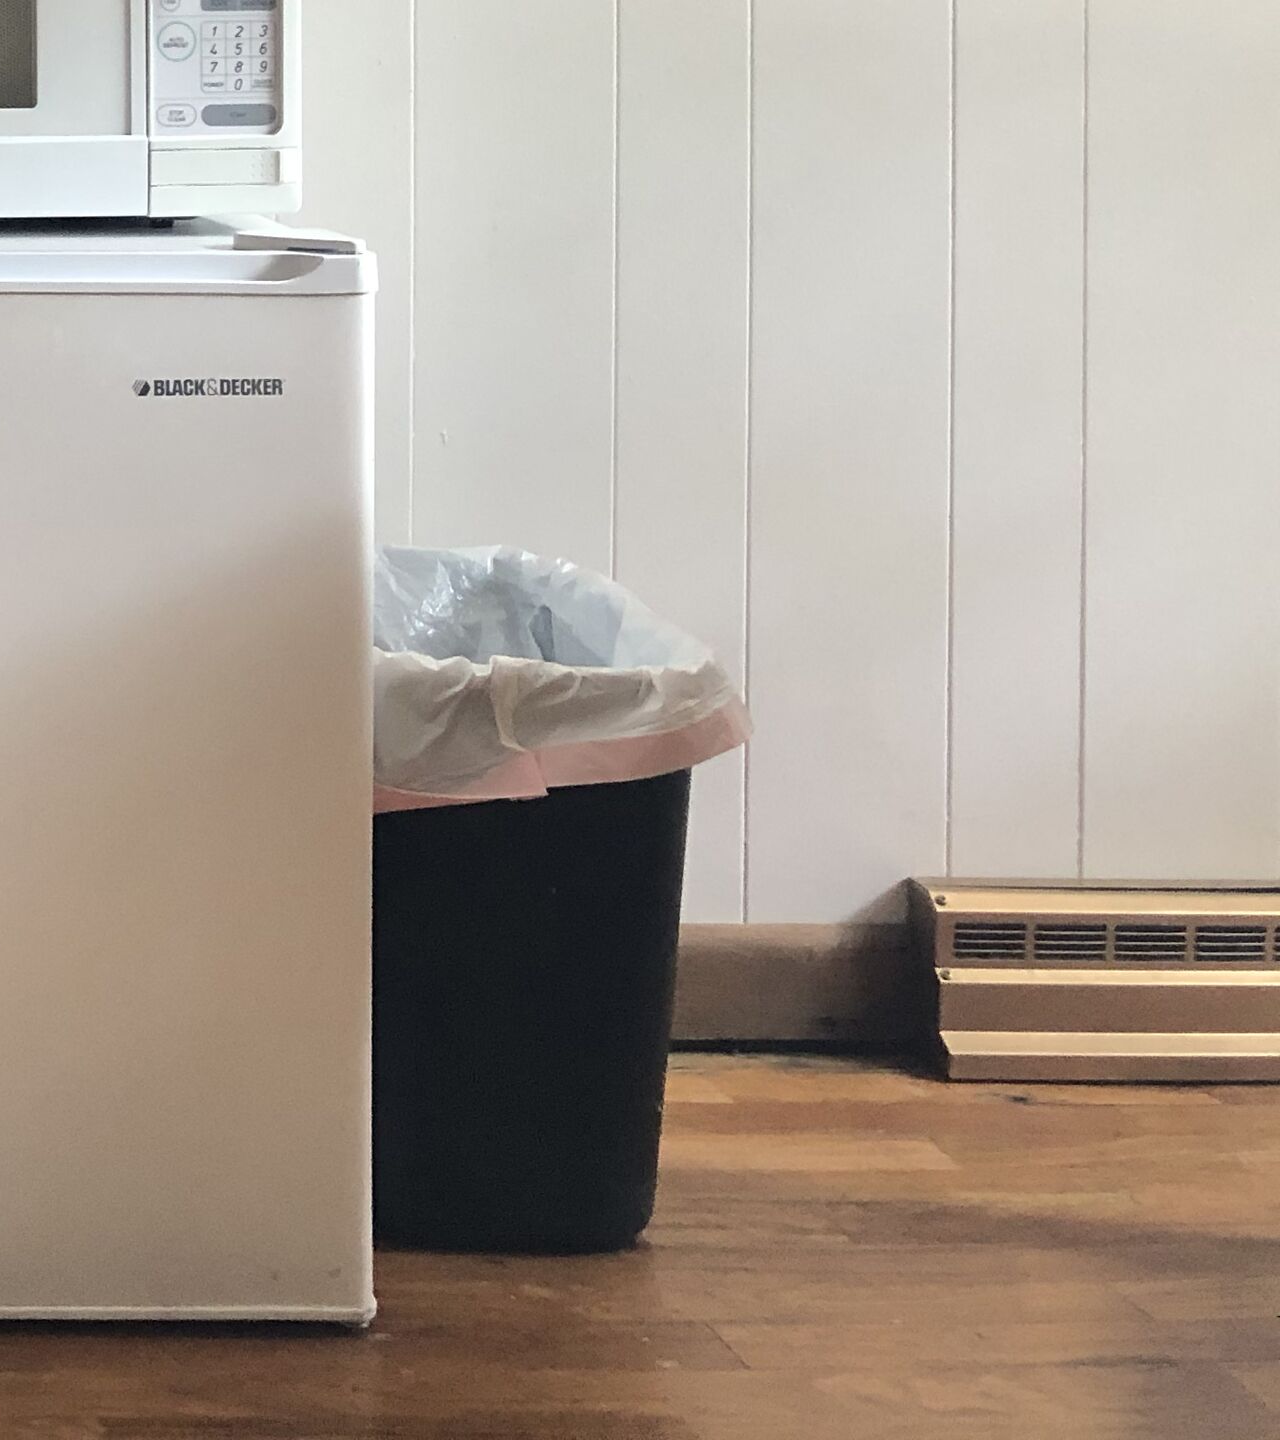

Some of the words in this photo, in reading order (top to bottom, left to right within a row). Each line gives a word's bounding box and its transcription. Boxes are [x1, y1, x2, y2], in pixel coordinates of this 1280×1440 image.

[212, 25, 218, 37] 1
[234, 25, 244, 38] 2
[259, 25, 268, 38] 3
[209, 44, 218, 55] 4
[234, 43, 243, 56] 5
[259, 43, 268, 55] 6
[210, 61, 219, 73] 7
[234, 61, 244, 73] 8
[259, 61, 268, 73] 9
[234, 78, 243, 91] 0
[153, 377, 284, 397] BLACK&DECKER
